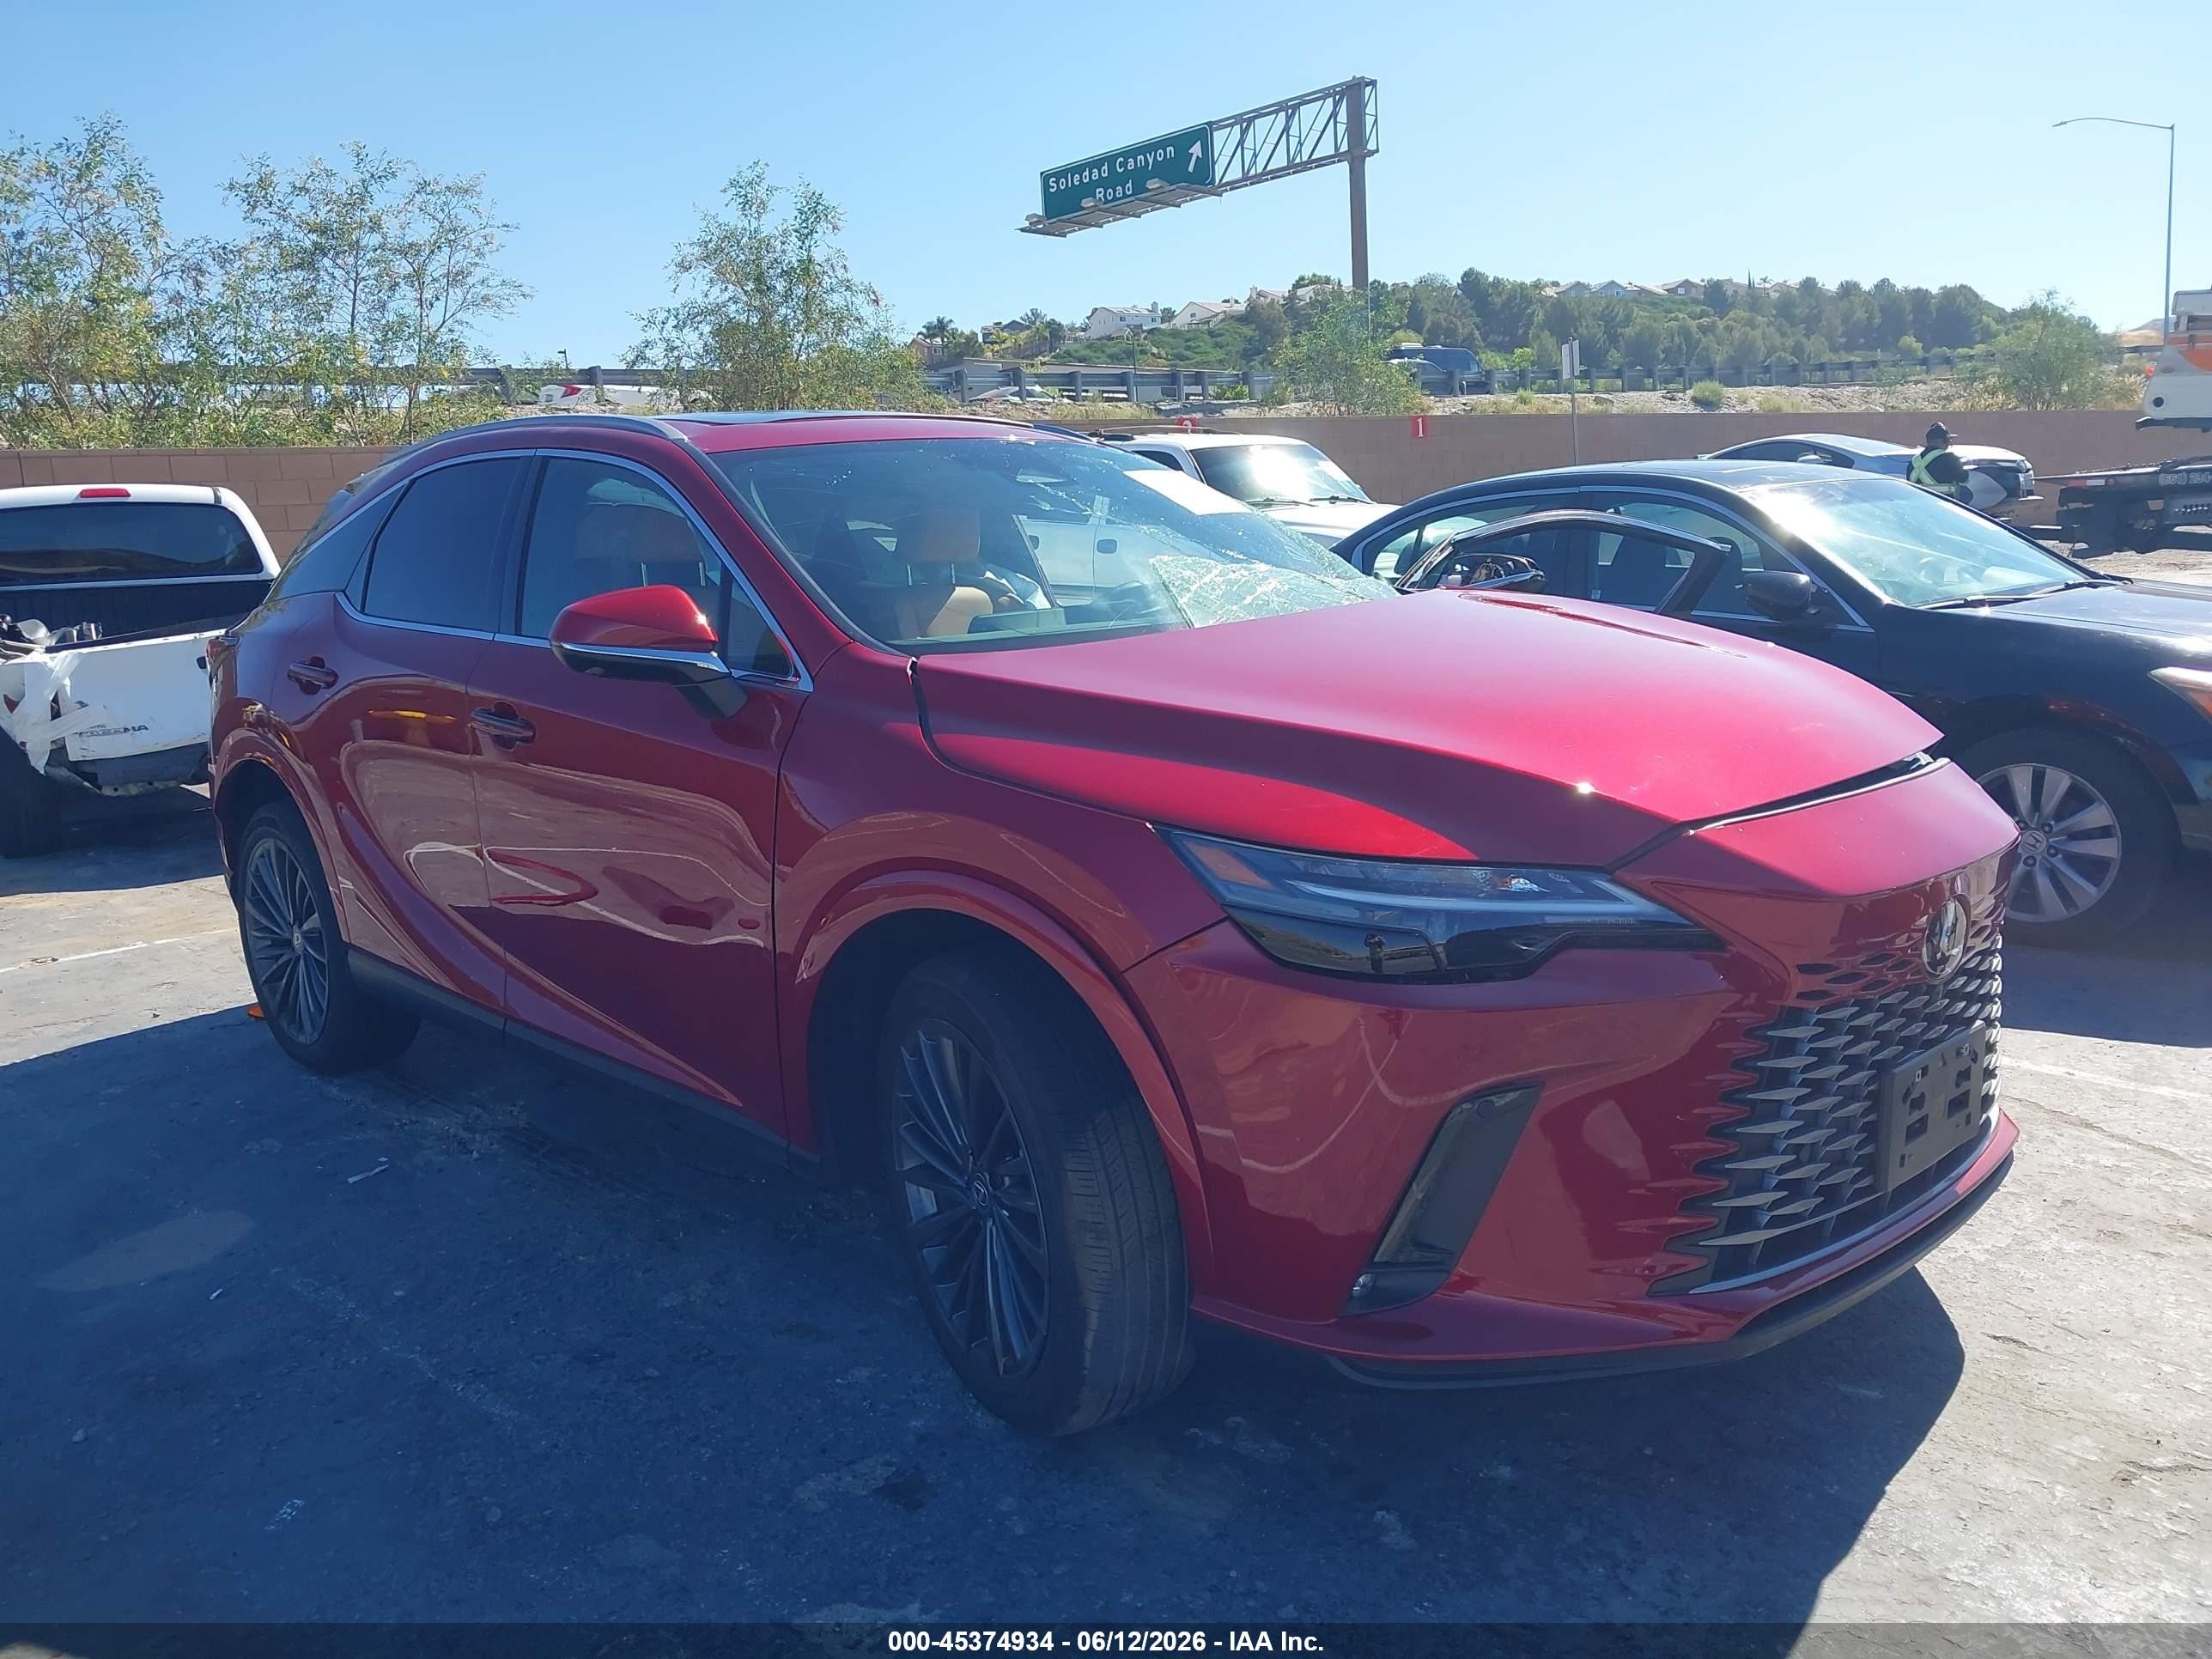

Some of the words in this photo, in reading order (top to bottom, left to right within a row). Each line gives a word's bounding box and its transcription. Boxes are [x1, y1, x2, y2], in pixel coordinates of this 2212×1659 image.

[1049, 161, 1109, 192] Soledad
[1116, 145, 1175, 173] Canyon
[1096, 179, 1133, 202] Road
[1416, 416, 1424, 437] 1
